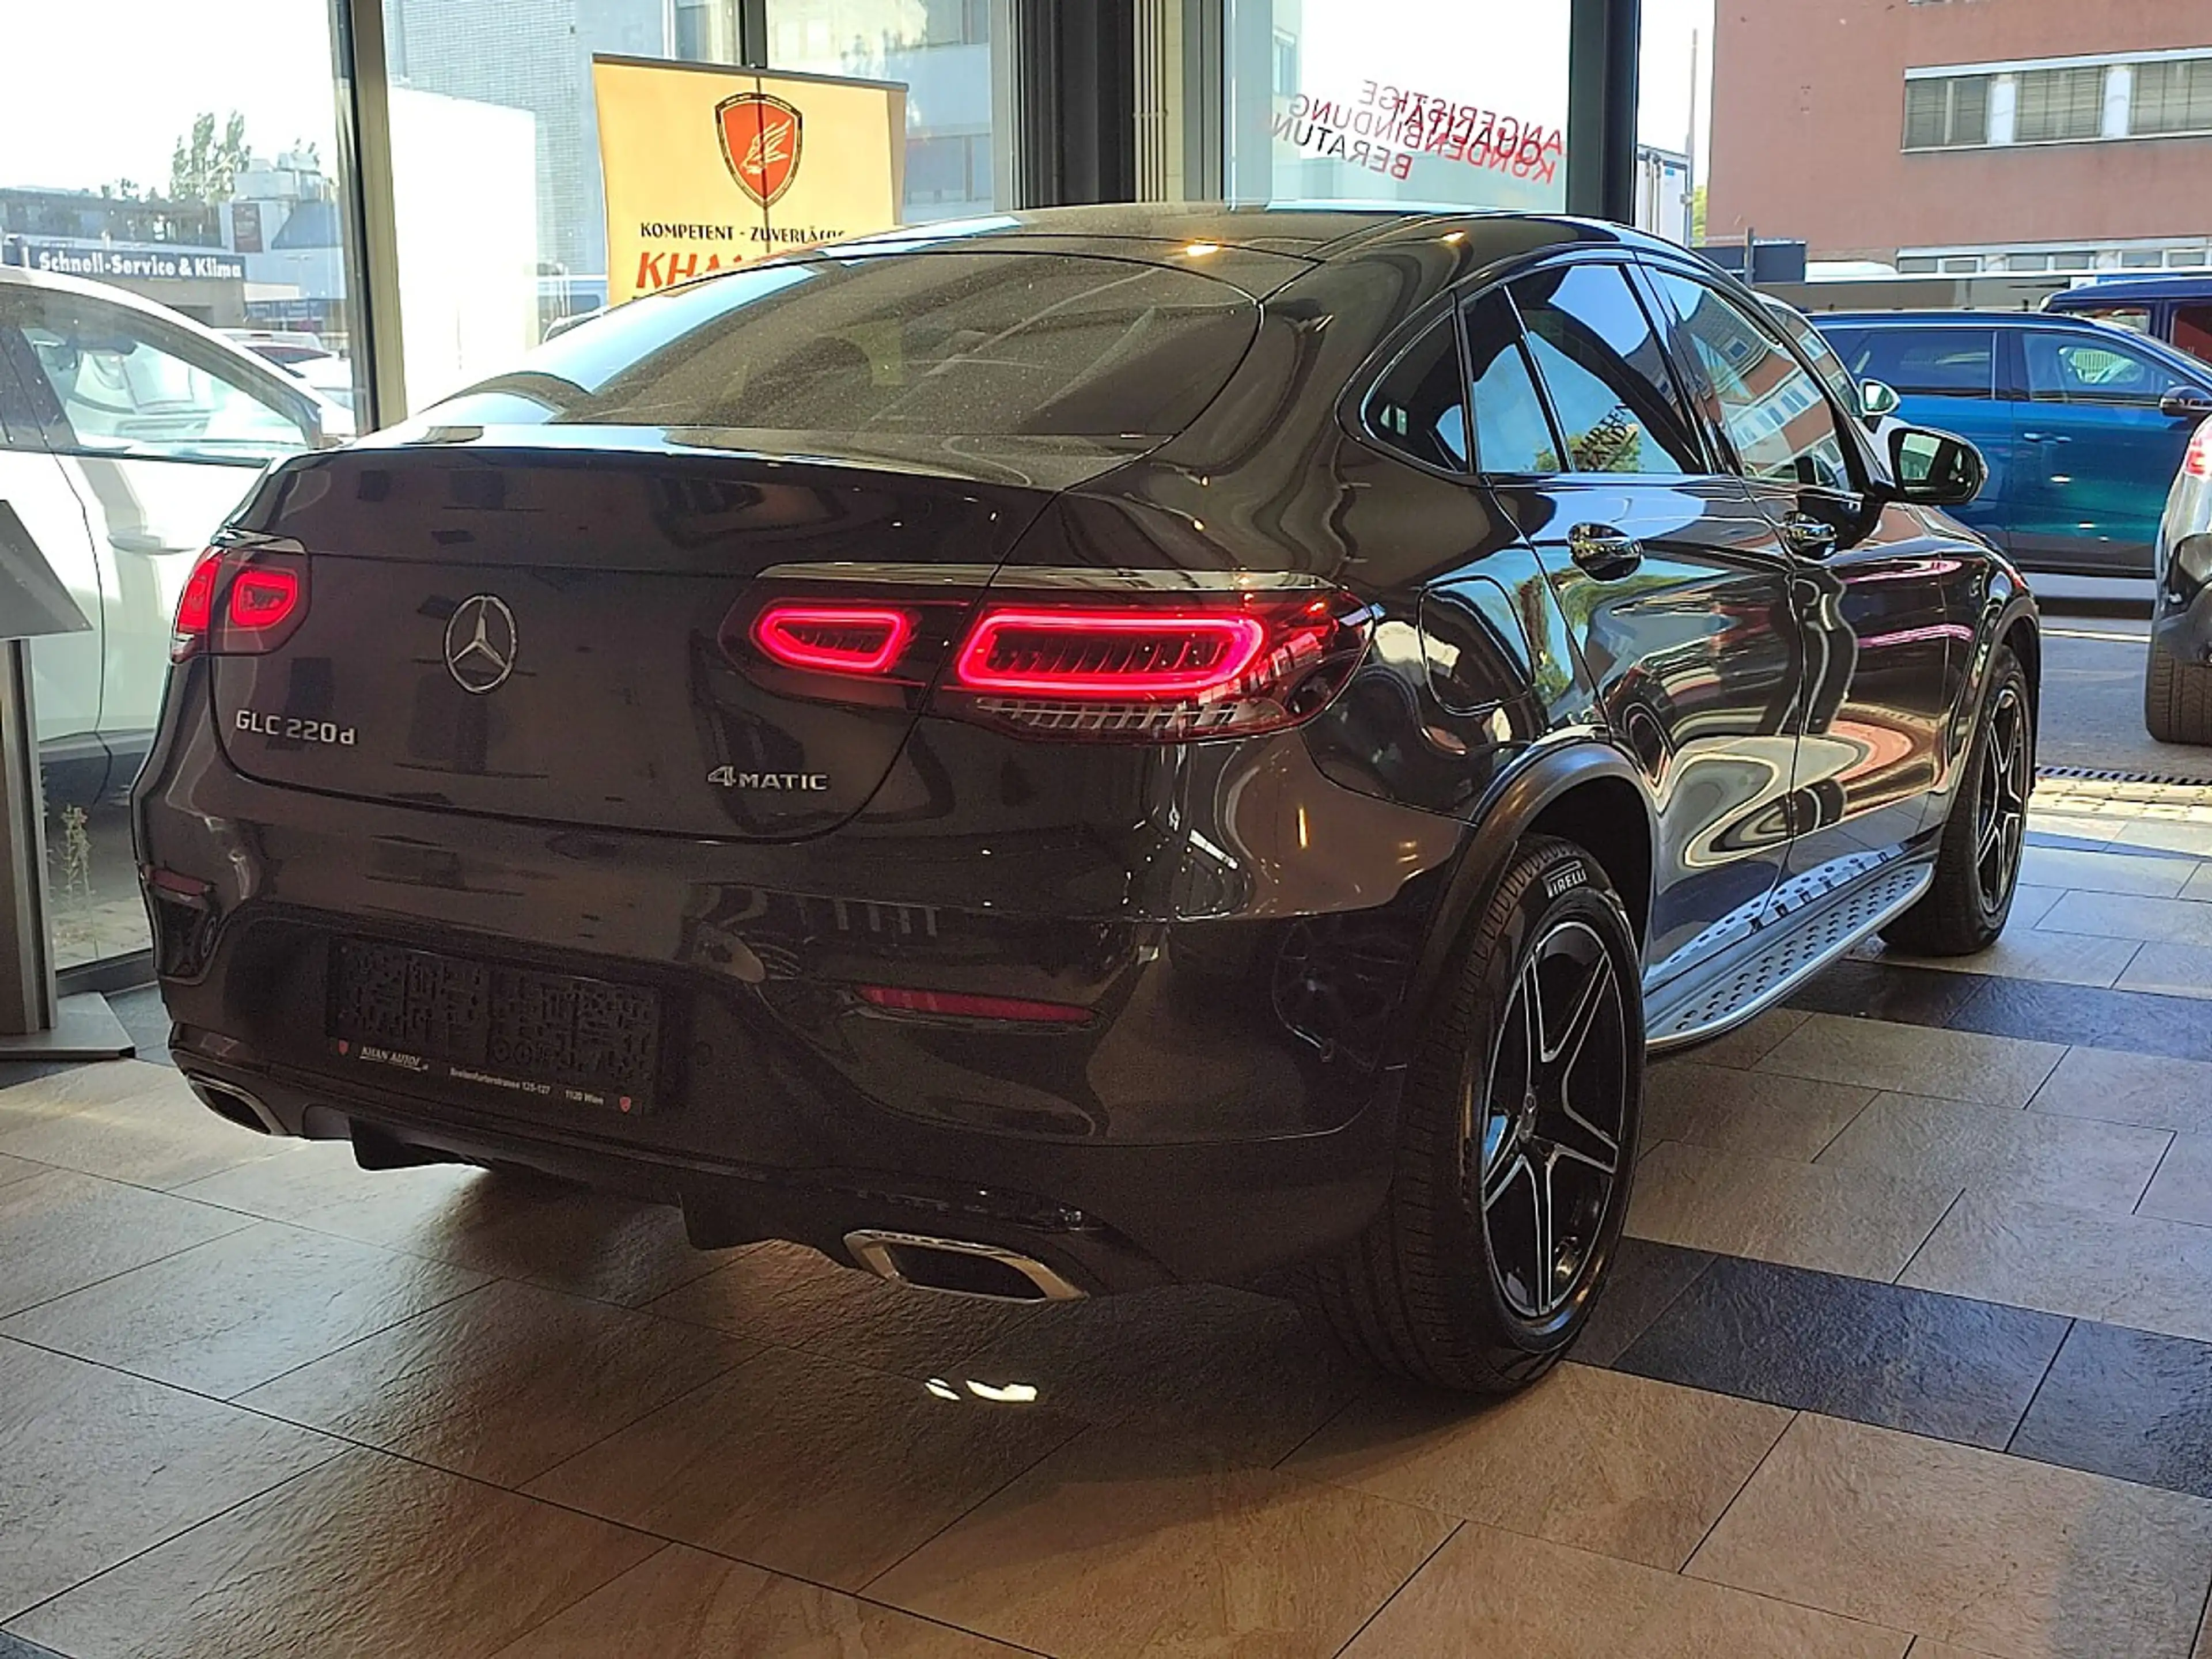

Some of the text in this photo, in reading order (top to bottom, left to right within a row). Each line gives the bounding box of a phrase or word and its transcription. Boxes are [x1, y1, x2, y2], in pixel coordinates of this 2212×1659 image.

[641, 223, 734, 241] KOMPETENT
[179, 260, 192, 276] &
[195, 257, 242, 279] Klima
[236, 709, 355, 744] GLC 220d
[707, 765, 828, 790] 4MATIC
[1541, 861, 1587, 898] PIRELLI
